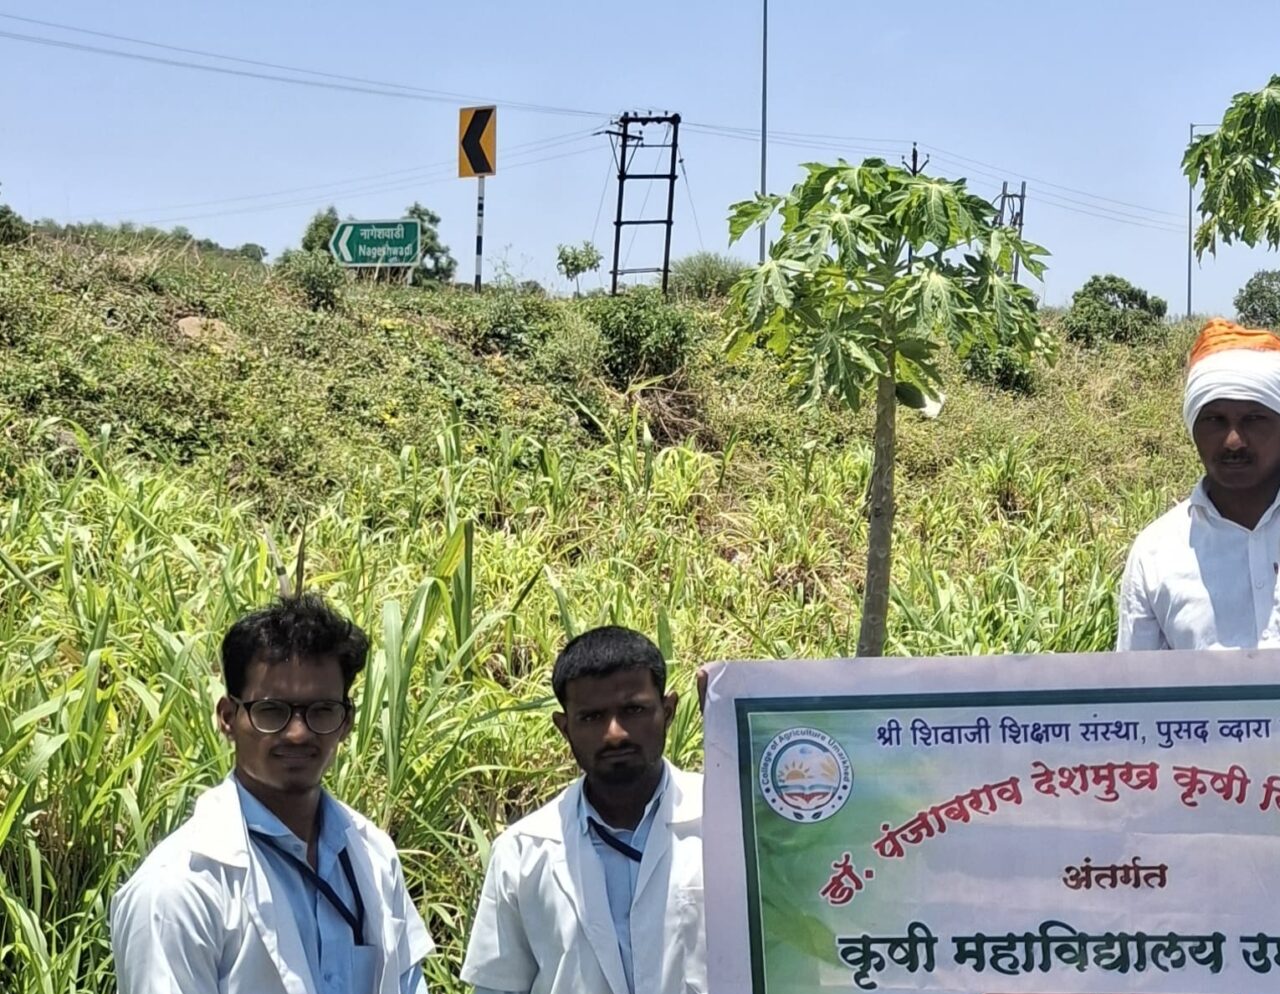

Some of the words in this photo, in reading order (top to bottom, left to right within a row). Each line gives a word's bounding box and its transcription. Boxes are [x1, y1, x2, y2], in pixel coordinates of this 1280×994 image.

[358, 243, 413, 259] Nageshwadi
[778, 728, 827, 744] Agriculture
[877, 719, 902, 746] श्री
[911, 717, 991, 745] शिवाजी
[1000, 716, 1071, 743] शिक्षण
[1080, 713, 1146, 744] संस्था,
[1157, 720, 1209, 748] पुसद
[820, 853, 874, 905] डॉ.
[873, 776, 1023, 859] पंजाबराव
[1031, 760, 1160, 802] देशमुख
[1172, 764, 1251, 807] कृषी
[1062, 856, 1169, 890] अंतर्गत
[838, 921, 938, 990] कृषी
[953, 919, 1226, 977] महाविद्यालय
